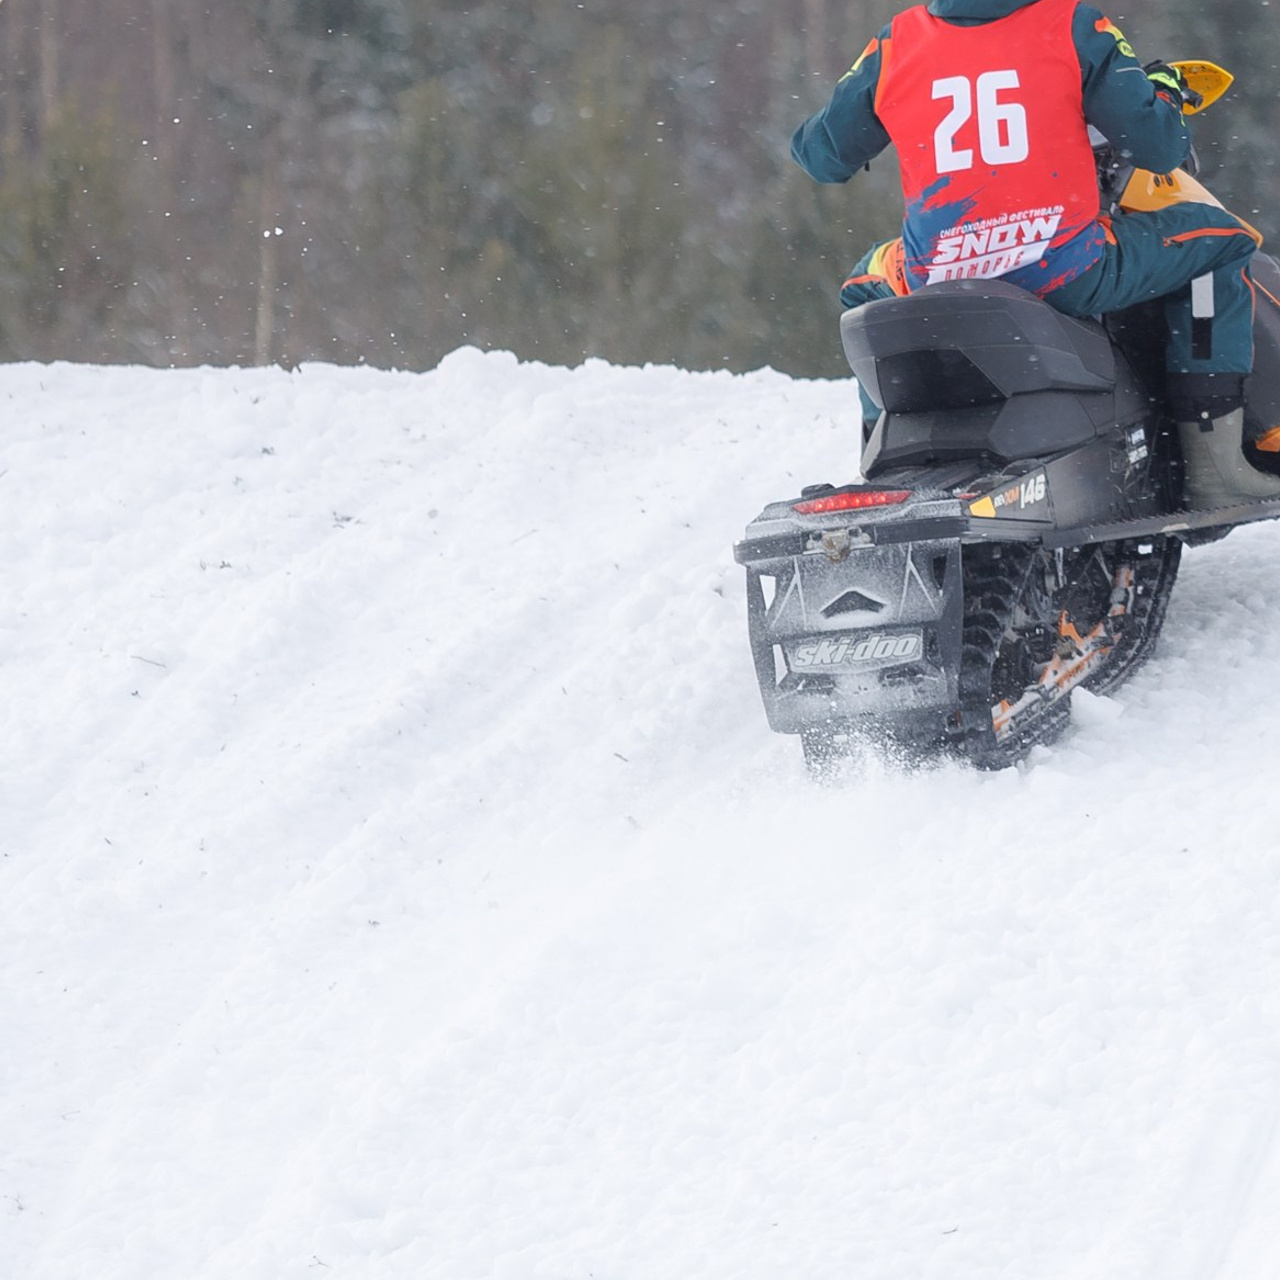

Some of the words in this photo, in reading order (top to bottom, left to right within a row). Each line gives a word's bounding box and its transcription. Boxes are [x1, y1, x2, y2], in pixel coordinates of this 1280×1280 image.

[932, 69, 1029, 174] 26
[932, 215, 1062, 264] SNOW
[939, 213, 1008, 239] СНЕГОХОДНЫЙ
[1008, 205, 1065, 221] ФЕСТИВАЛЬ
[1020, 474, 1046, 509] 146
[794, 634, 920, 667] ski-doo
